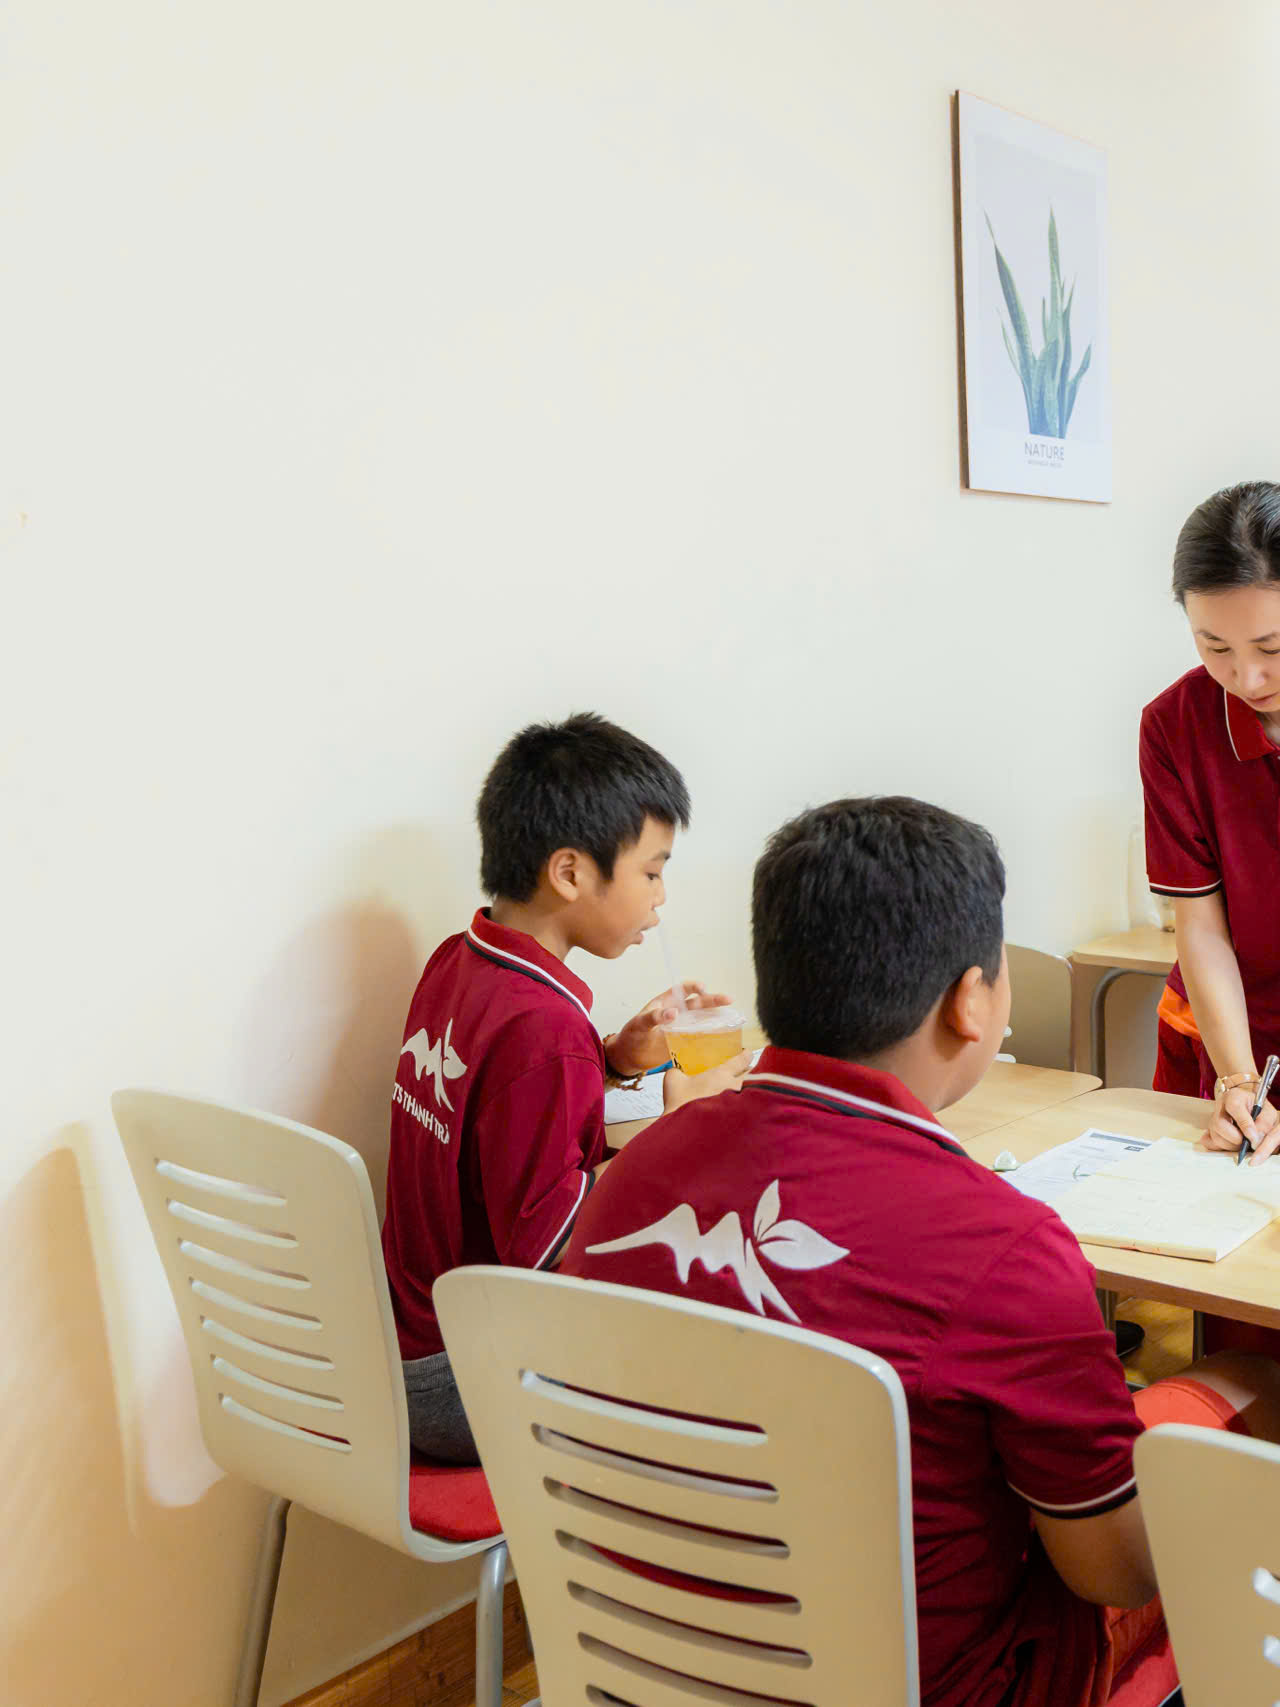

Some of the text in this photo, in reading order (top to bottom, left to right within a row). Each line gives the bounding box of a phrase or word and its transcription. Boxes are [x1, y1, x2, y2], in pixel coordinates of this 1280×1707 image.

[1023, 441, 1065, 461] NATURE
[403, 1090, 434, 1131] THANH
[434, 1117, 450, 1144] TRÀ
